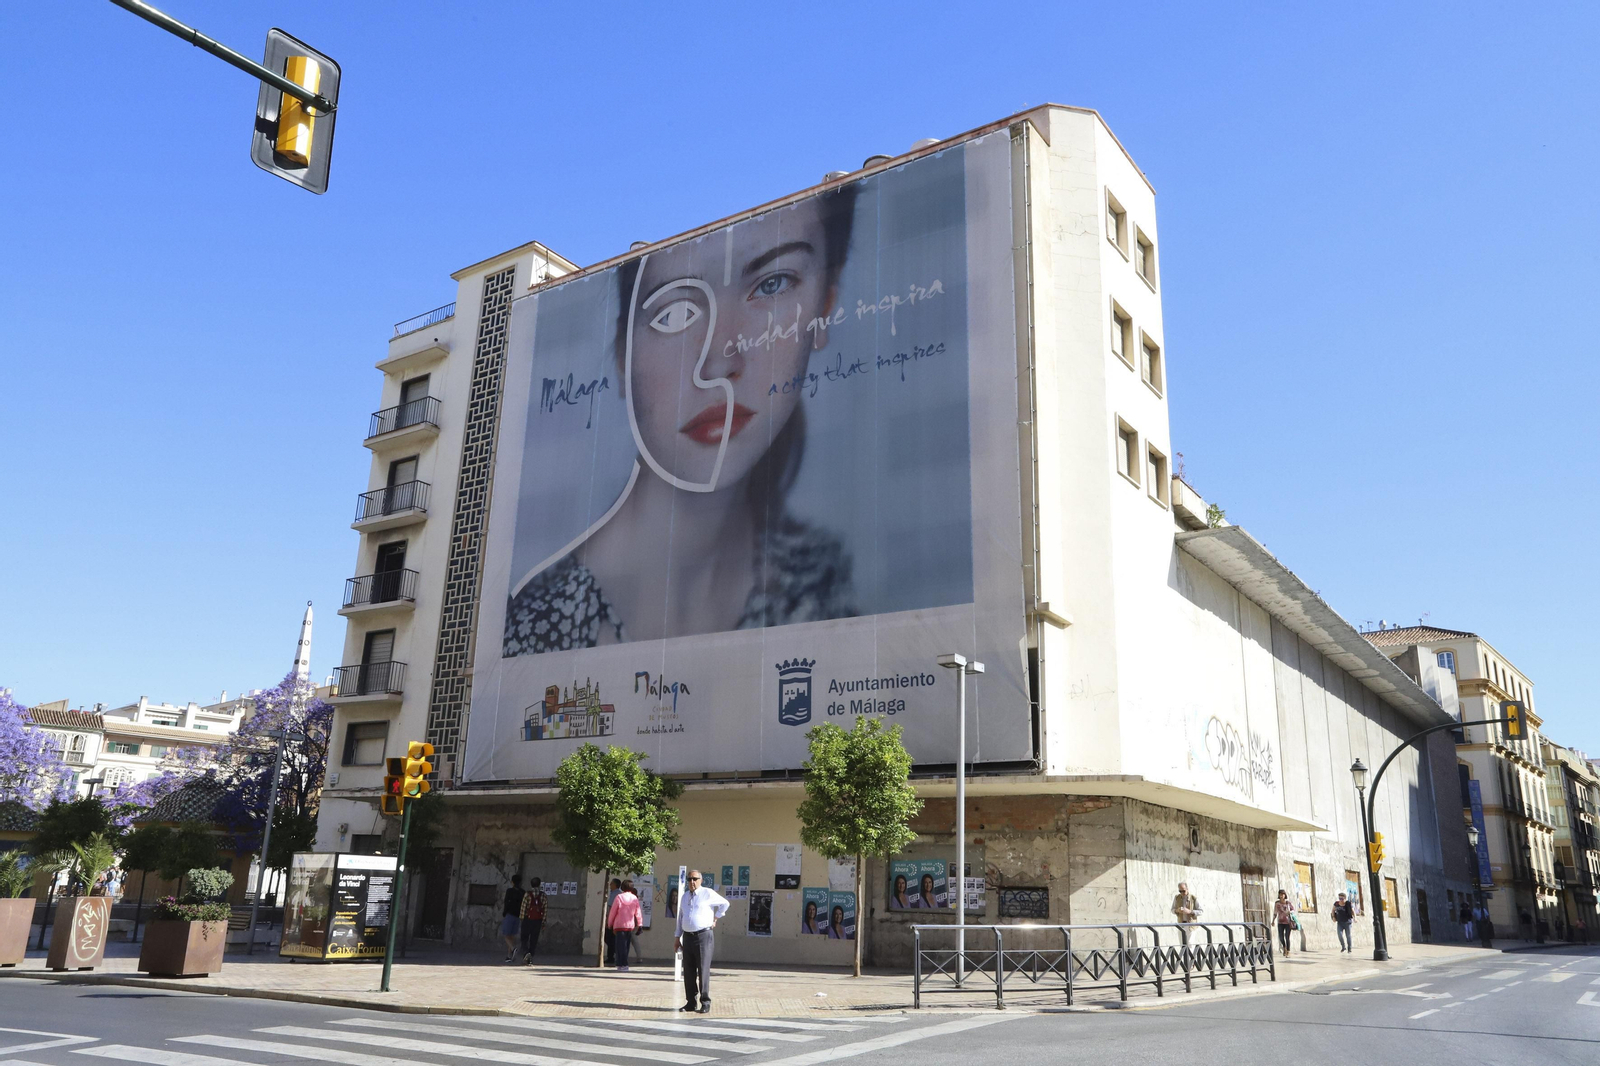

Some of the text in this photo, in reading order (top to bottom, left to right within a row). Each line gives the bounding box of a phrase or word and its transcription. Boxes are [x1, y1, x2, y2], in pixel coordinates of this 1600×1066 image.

[723, 279, 945, 358] ciudad que inspira
[768, 383, 778, 396] a
[824, 352, 869, 381] that
[876, 342, 946, 382] inspires
[540, 372, 609, 429] Málaga
[635, 671, 690, 713] Málaga
[827, 698, 905, 716] de Málaga
[828, 672, 935, 696] Ayuntamiento
